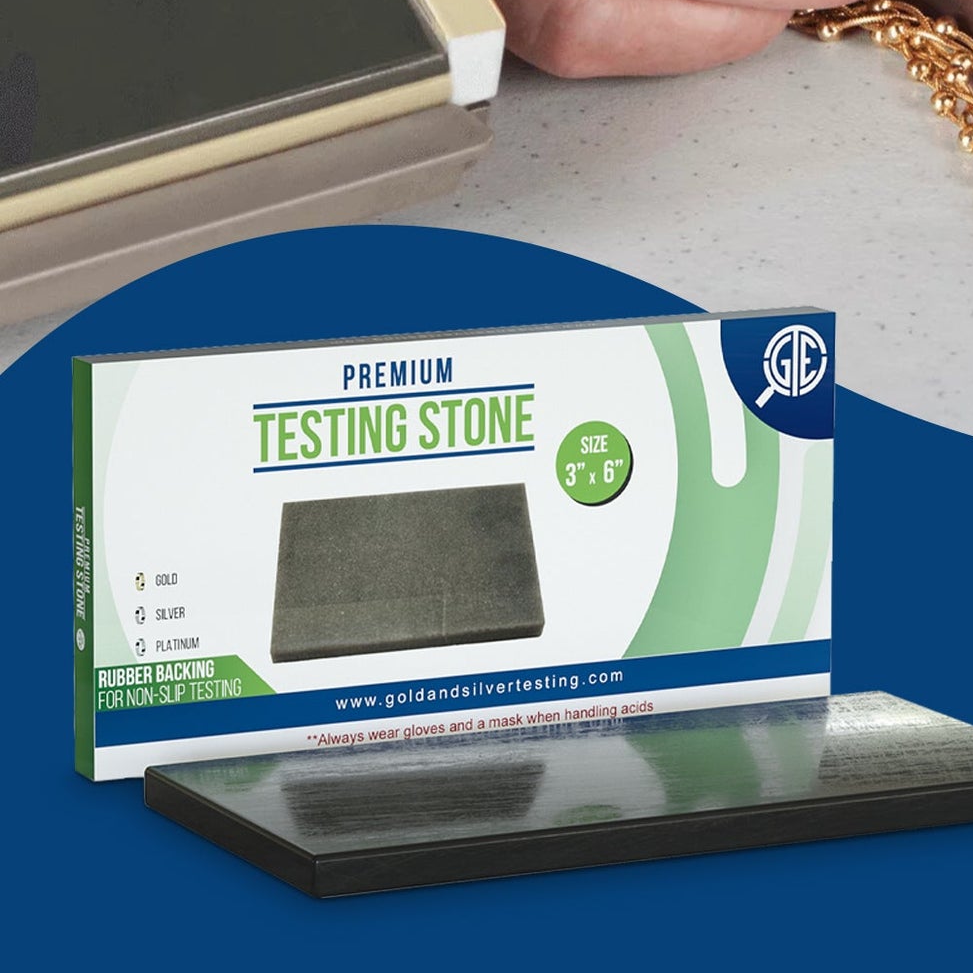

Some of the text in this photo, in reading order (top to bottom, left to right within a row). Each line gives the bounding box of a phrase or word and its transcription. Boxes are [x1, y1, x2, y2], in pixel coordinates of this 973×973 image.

[343, 357, 453, 390] PREMIUM
[253, 394, 535, 463] TESTING STONE
[580, 434, 608, 454] SIZE
[75, 506, 86, 567] TESTING
[155, 573, 178, 586] GOLD
[75, 570, 86, 622] STONE
[155, 606, 186, 621] SILVER
[155, 637, 200, 652] PLATINUM
[98, 659, 215, 688] RUBBER BACKING
[335, 670, 623, 709] www.goldandsilvertesting.com
[98, 678, 242, 709] FOR NON-SLIP TESTING
[368, 728, 400, 741] wear
[403, 724, 445, 739] gloves
[449, 718, 473, 732] and
[477, 721, 485, 730] a
[488, 713, 523, 728] mask
[526, 711, 561, 725] when
[564, 705, 617, 720] handling
[620, 700, 654, 715] acids
